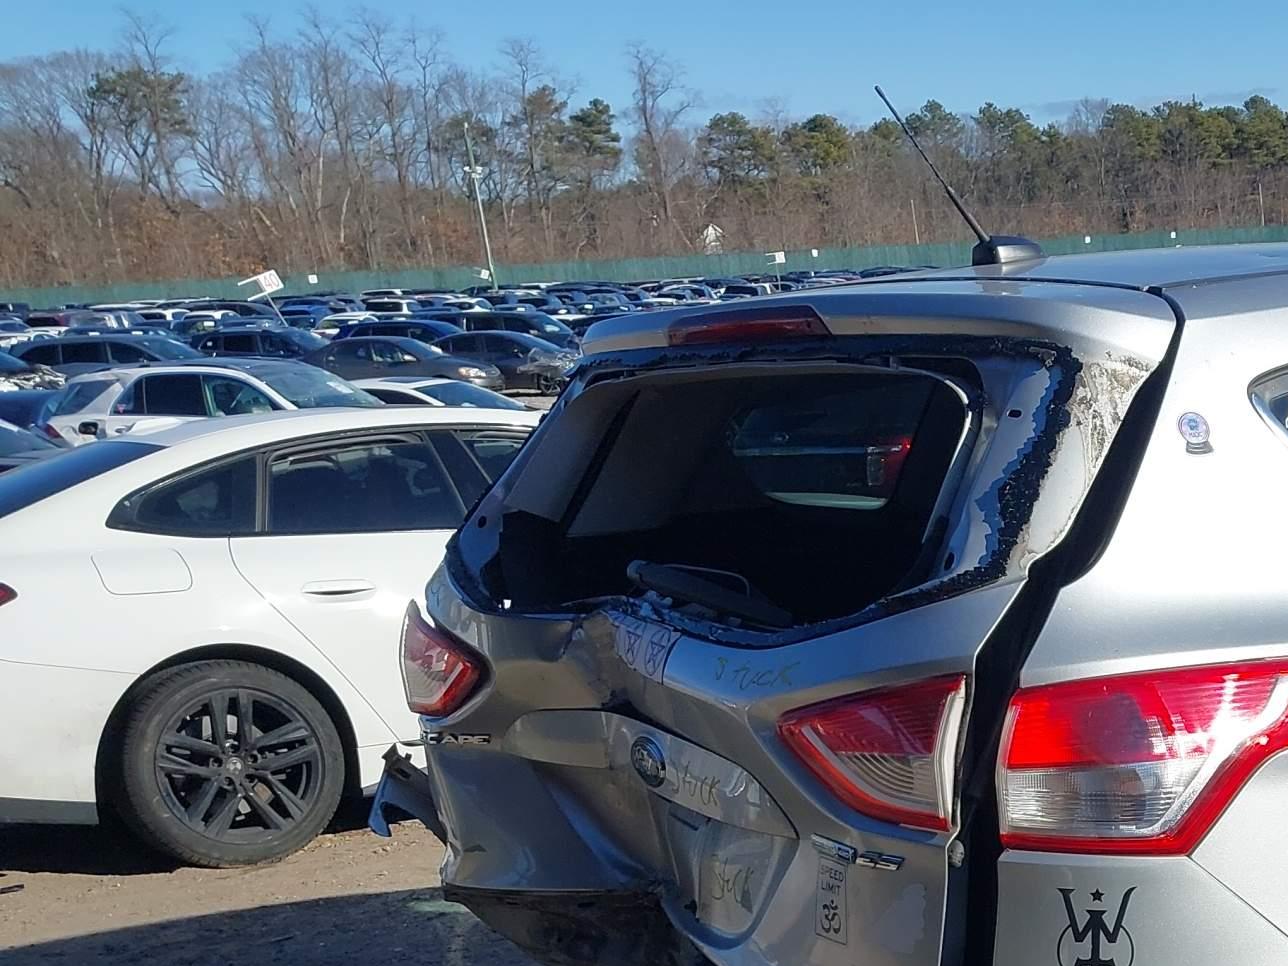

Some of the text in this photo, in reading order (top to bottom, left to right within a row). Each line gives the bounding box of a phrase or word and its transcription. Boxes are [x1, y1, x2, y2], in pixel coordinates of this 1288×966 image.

[263, 273, 280, 289] 40
[422, 730, 490, 745] CAPE
[820, 864, 844, 882] SPEED
[821, 880, 842, 896] LIMIT
